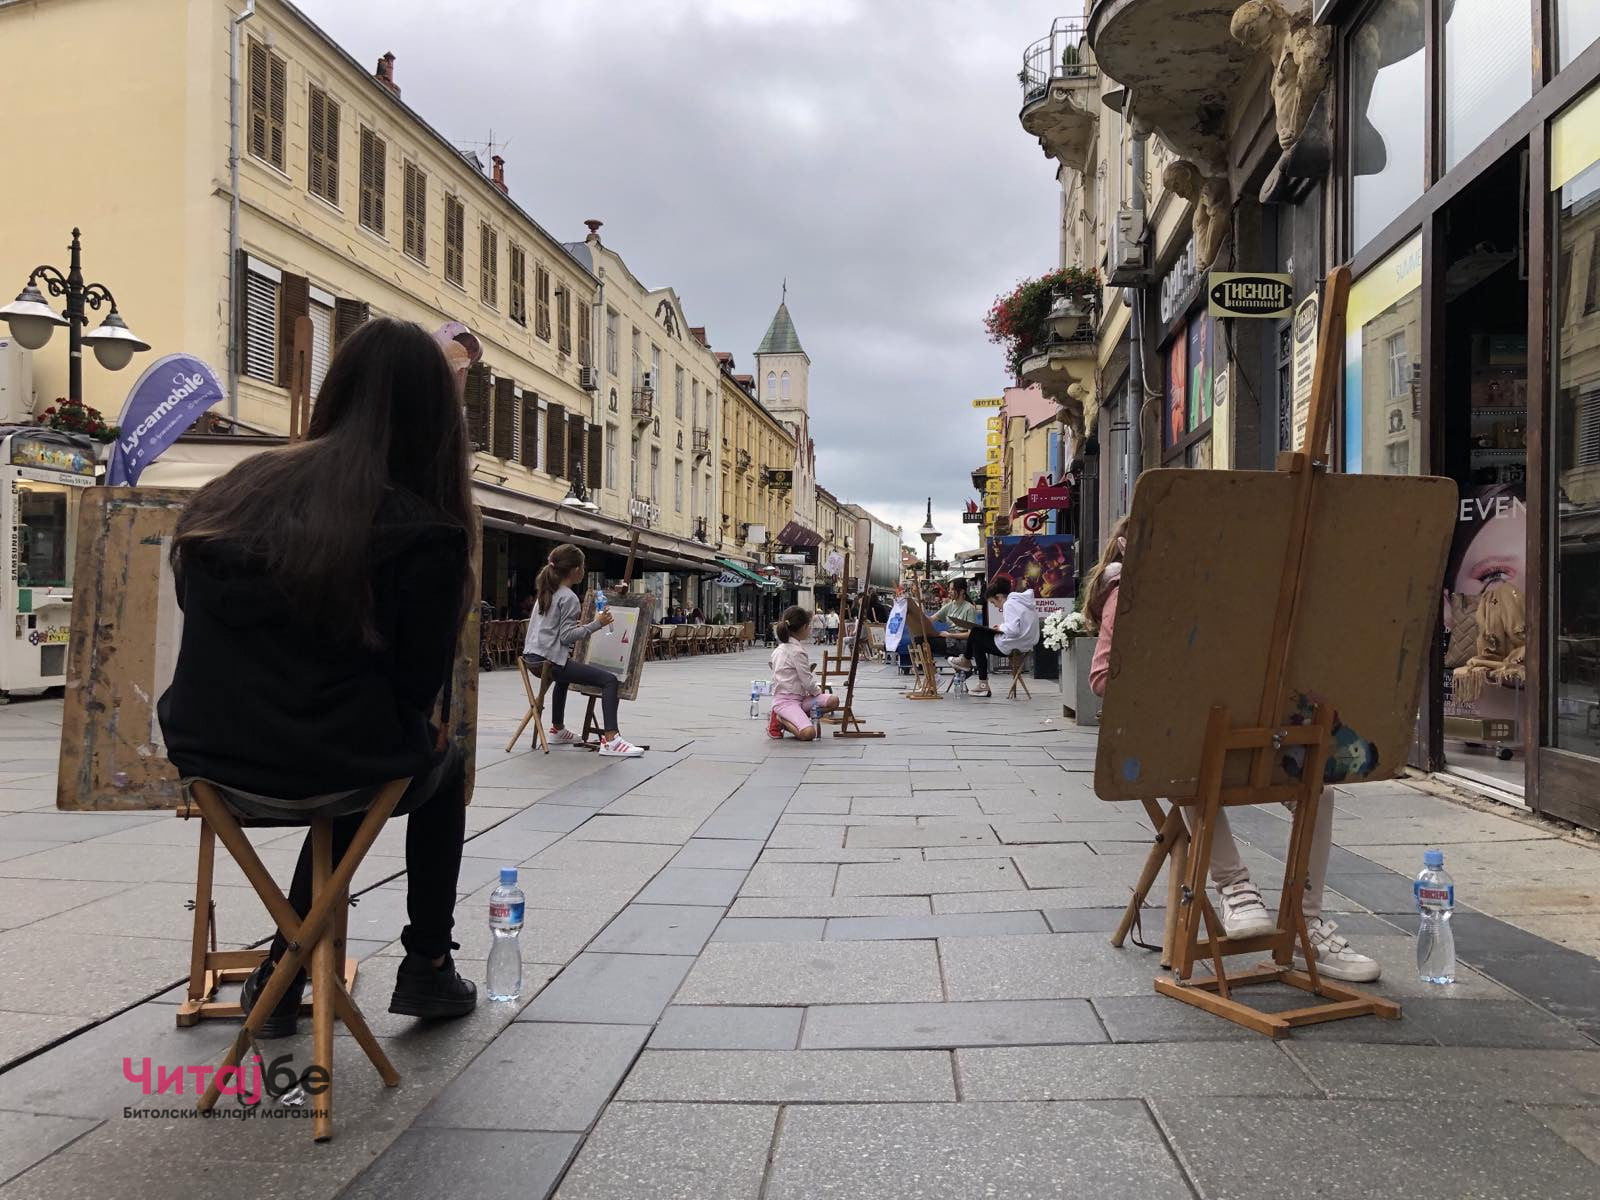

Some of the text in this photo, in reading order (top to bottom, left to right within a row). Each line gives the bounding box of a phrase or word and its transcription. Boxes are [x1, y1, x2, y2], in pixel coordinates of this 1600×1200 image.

[975, 399, 1002, 407] HOTEL
[121, 372, 205, 456] Lycamobile
[11, 480, 19, 494] CAT
